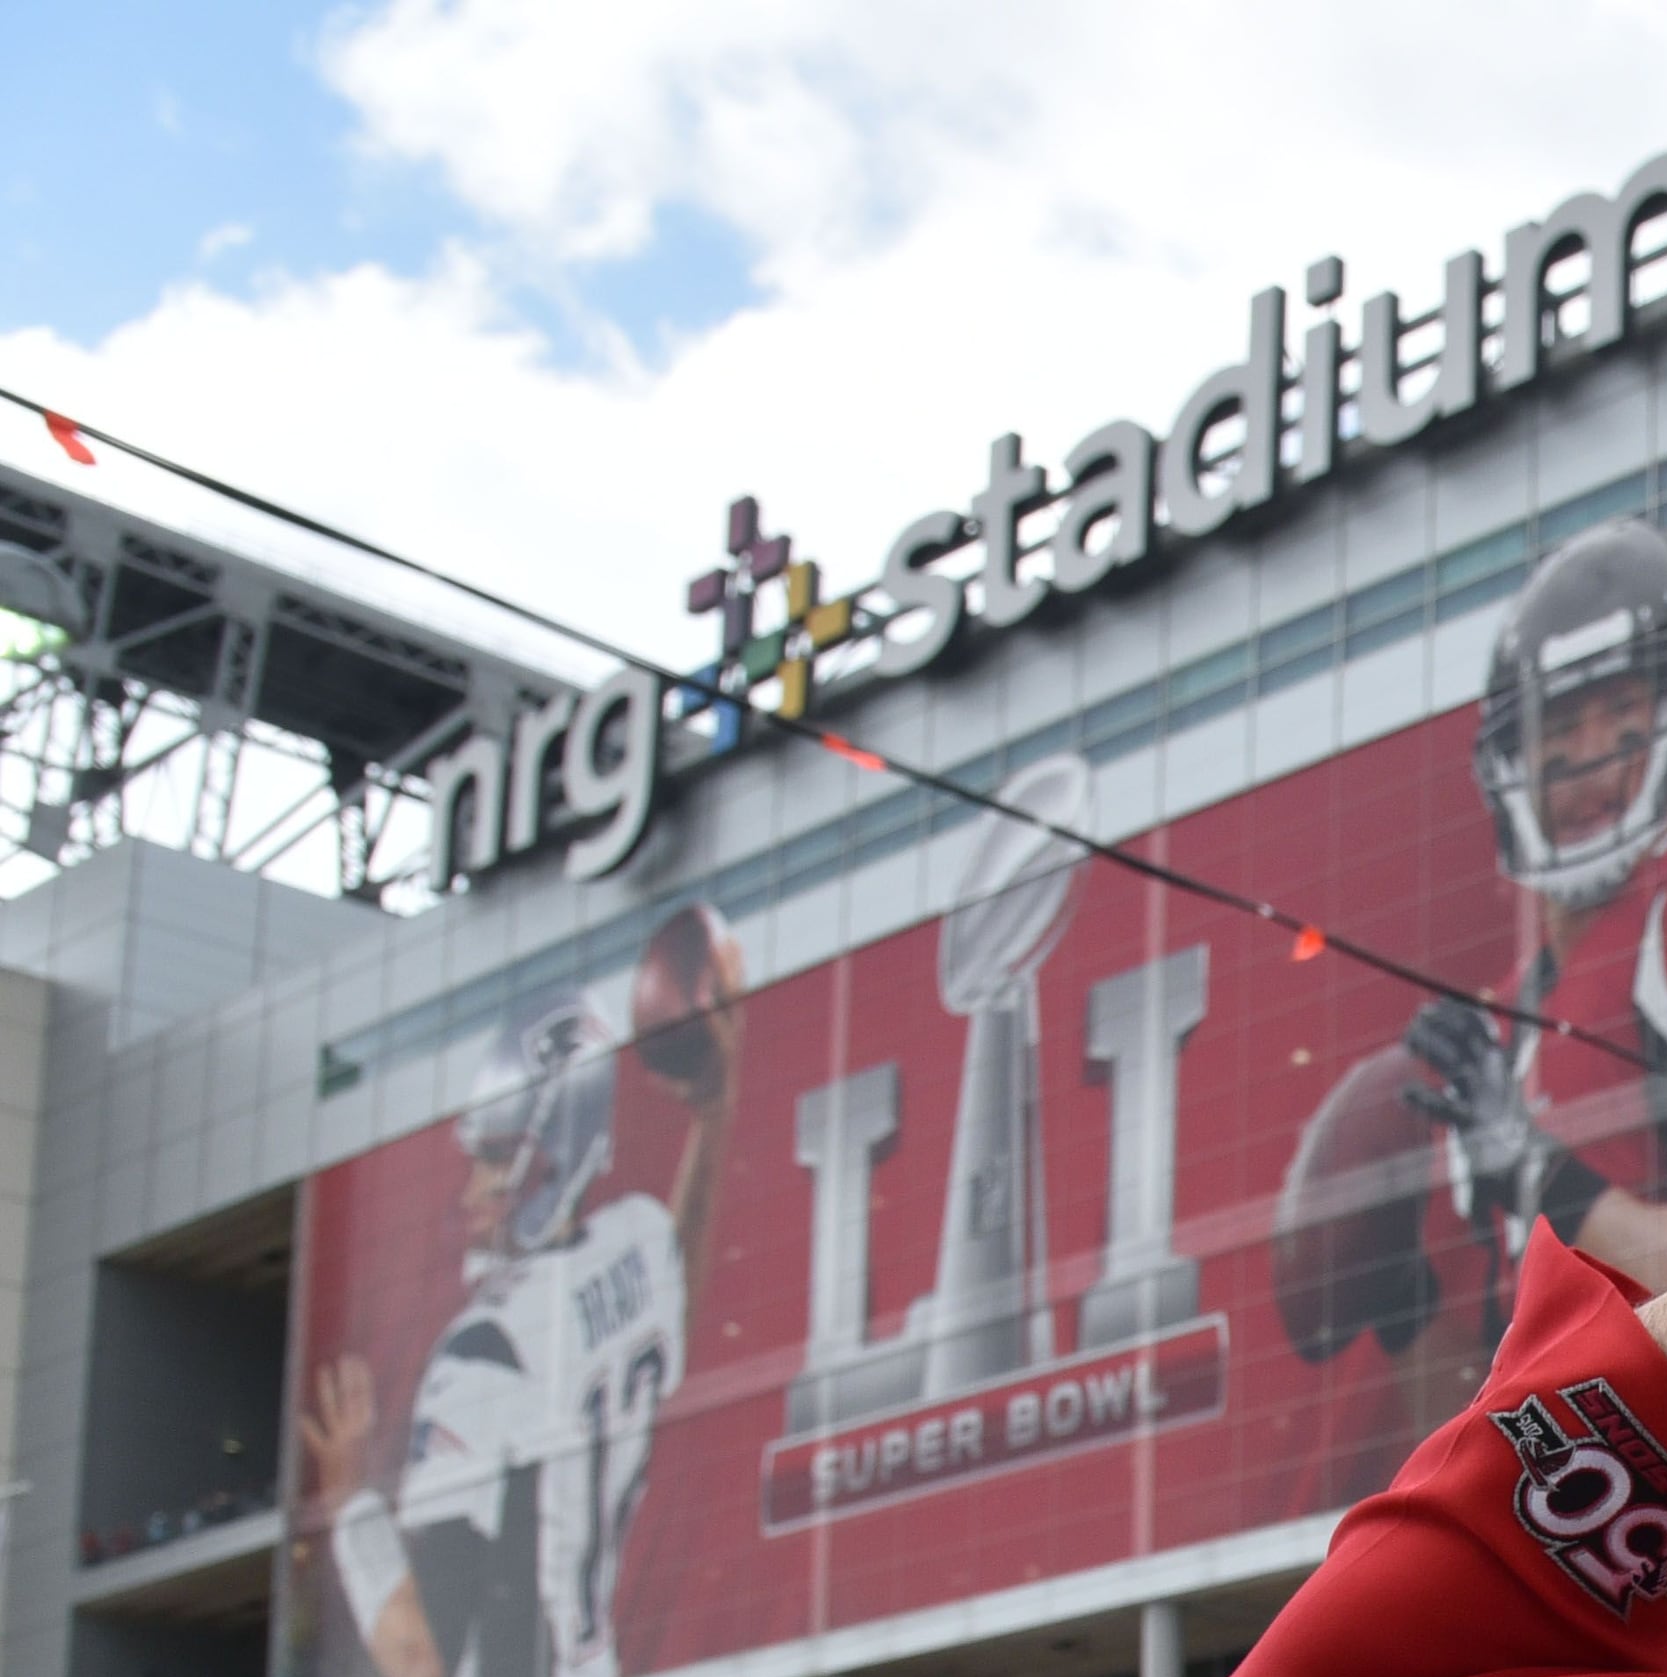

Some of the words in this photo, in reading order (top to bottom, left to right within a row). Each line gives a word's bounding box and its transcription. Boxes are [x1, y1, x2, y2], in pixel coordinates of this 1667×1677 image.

[426, 662, 660, 890] nrg
[811, 1407, 984, 1504] SUPER
[1008, 1355, 1168, 1450] BOWL
